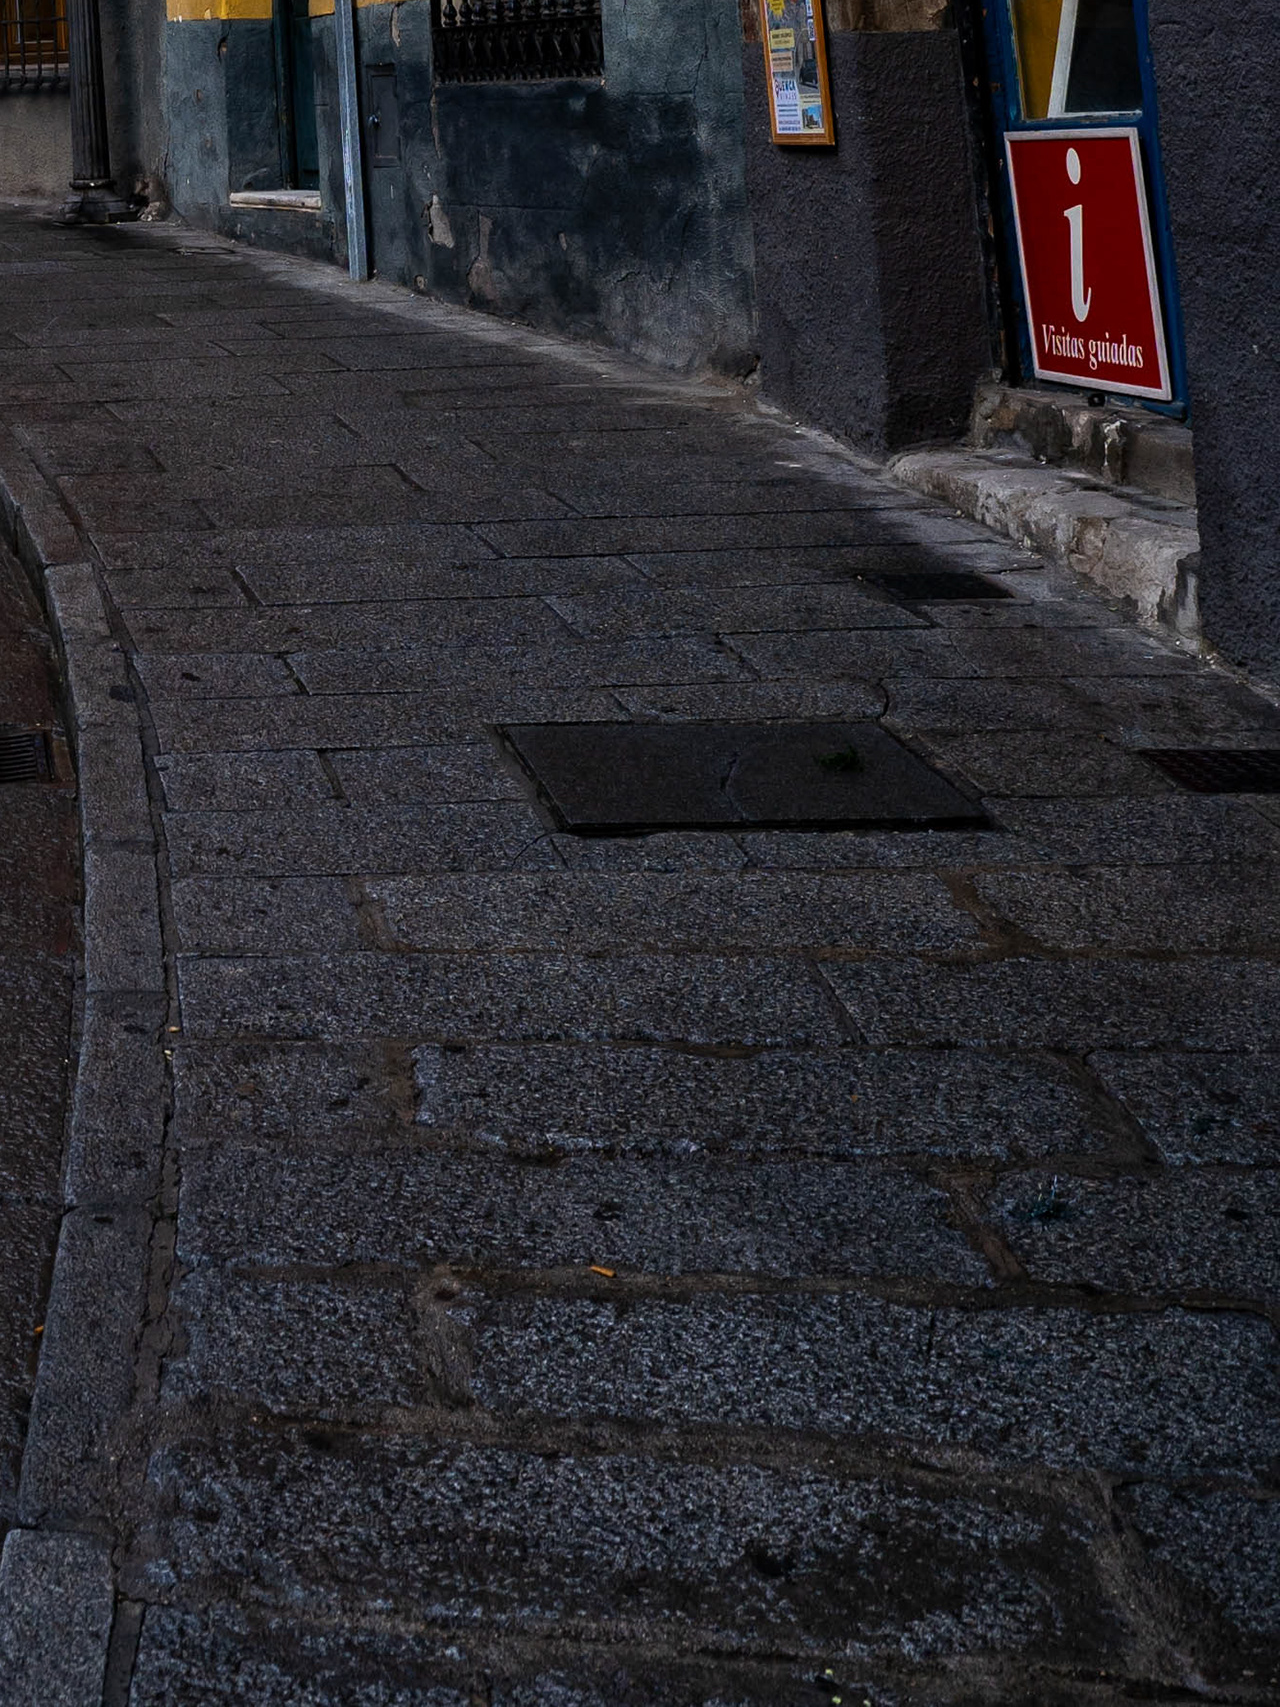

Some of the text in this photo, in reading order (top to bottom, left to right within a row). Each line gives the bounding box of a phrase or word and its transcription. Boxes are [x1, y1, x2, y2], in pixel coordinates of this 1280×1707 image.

[1063, 147, 1092, 322] i
[1042, 323, 1144, 371] Visitas guiadas
